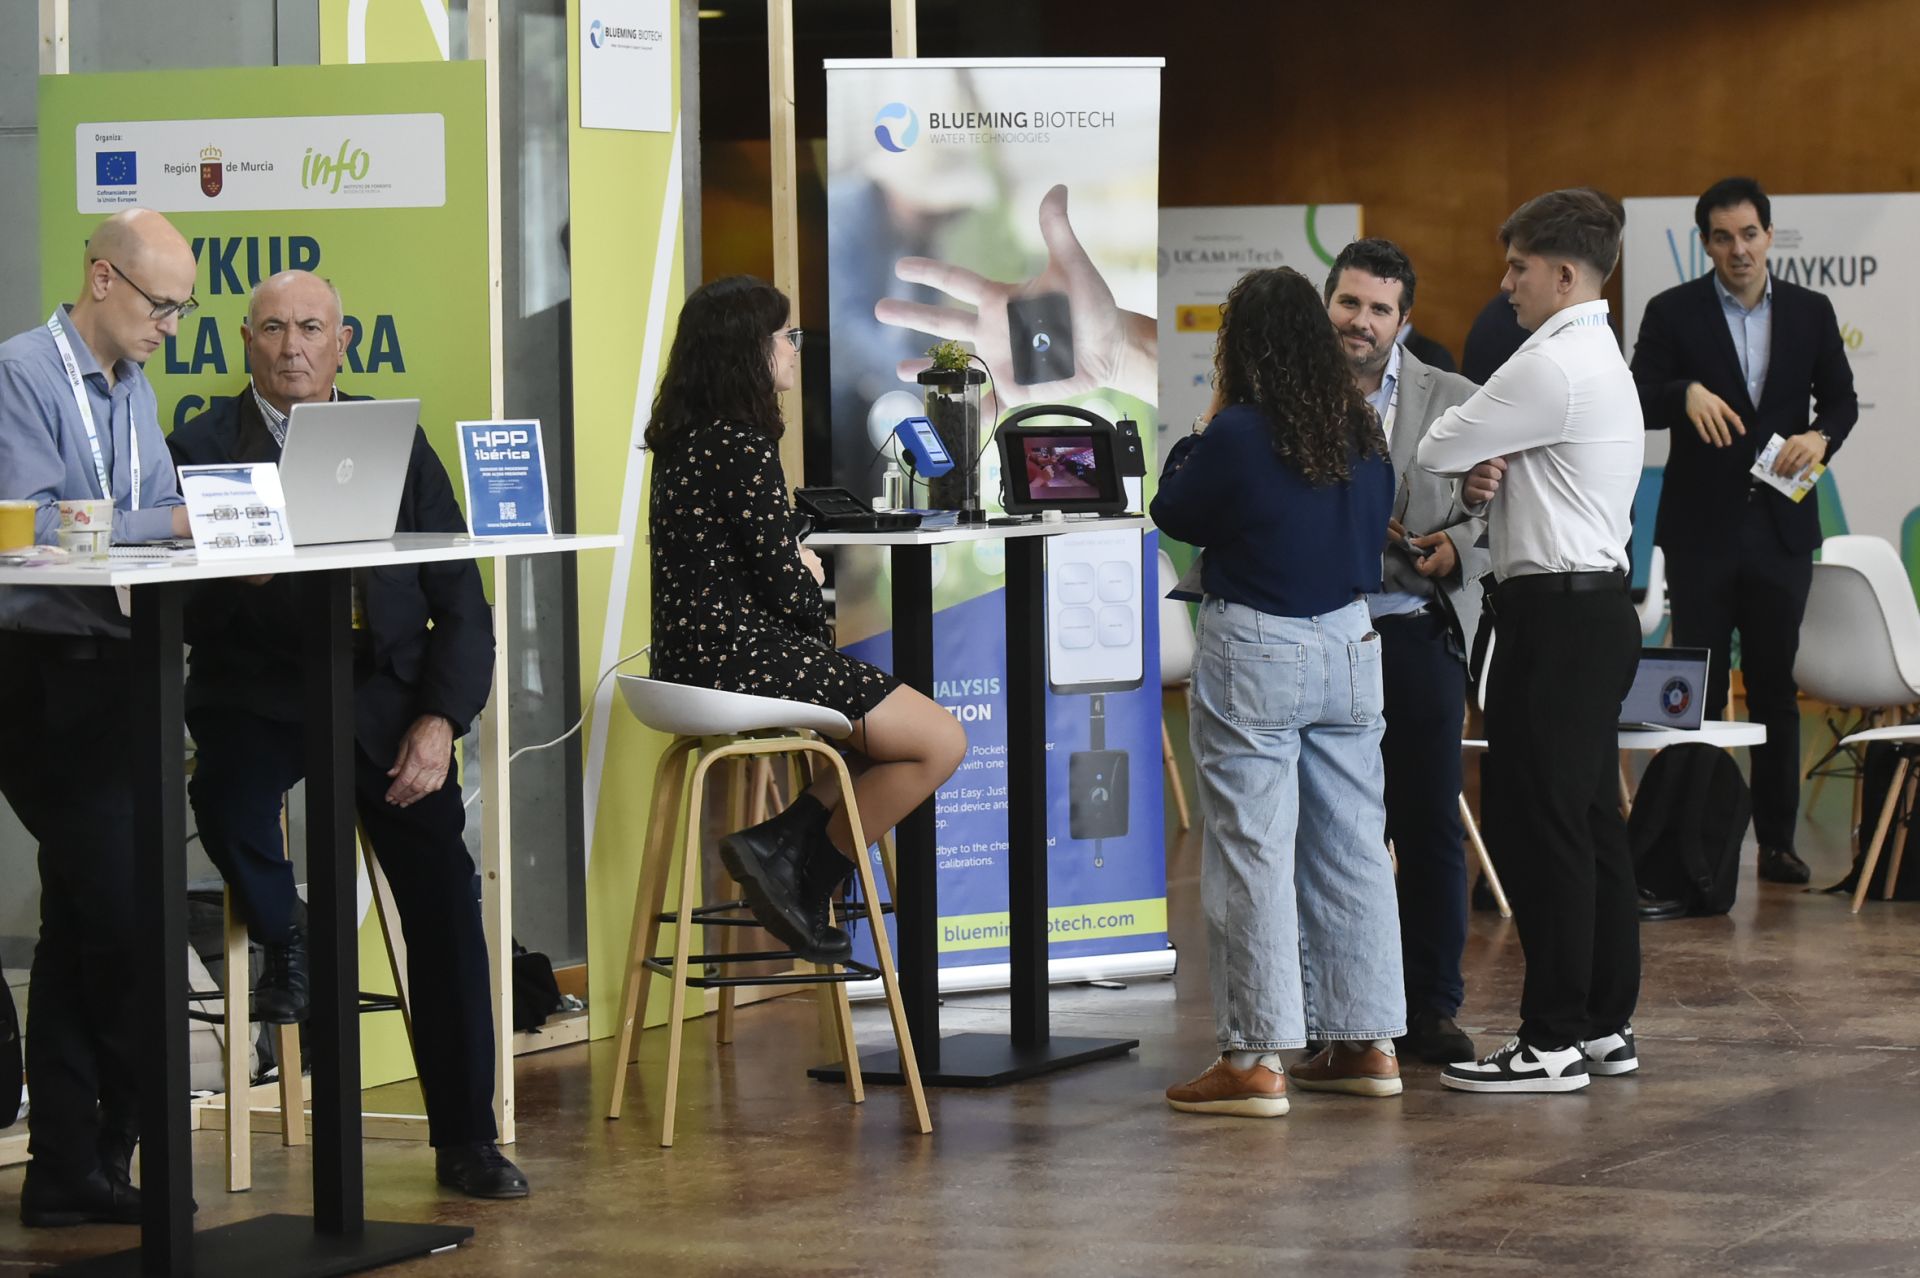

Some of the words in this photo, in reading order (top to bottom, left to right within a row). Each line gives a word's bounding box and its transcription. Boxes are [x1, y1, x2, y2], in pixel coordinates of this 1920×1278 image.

[605, 26, 637, 40] BLUEMING
[638, 29, 663, 42] BIOTECH
[929, 111, 1028, 130] BLUEMING
[1033, 110, 1115, 129] BIOTECH
[95, 133, 124, 144] Organiza:
[929, 133, 966, 145] WATER
[164, 162, 198, 176] Región
[226, 161, 239, 173] de
[241, 160, 274, 173] Murcia
[300, 138, 371, 195] info
[165, 316, 229, 375] LA
[471, 430, 529, 449] HPP
[474, 448, 531, 461] ibérica
[963, 760, 984, 771] with
[985, 759, 1005, 769] one
[940, 789, 959, 801] and
[960, 800, 992, 813] device
[960, 843, 971, 854] to
[972, 842, 988, 853] the
